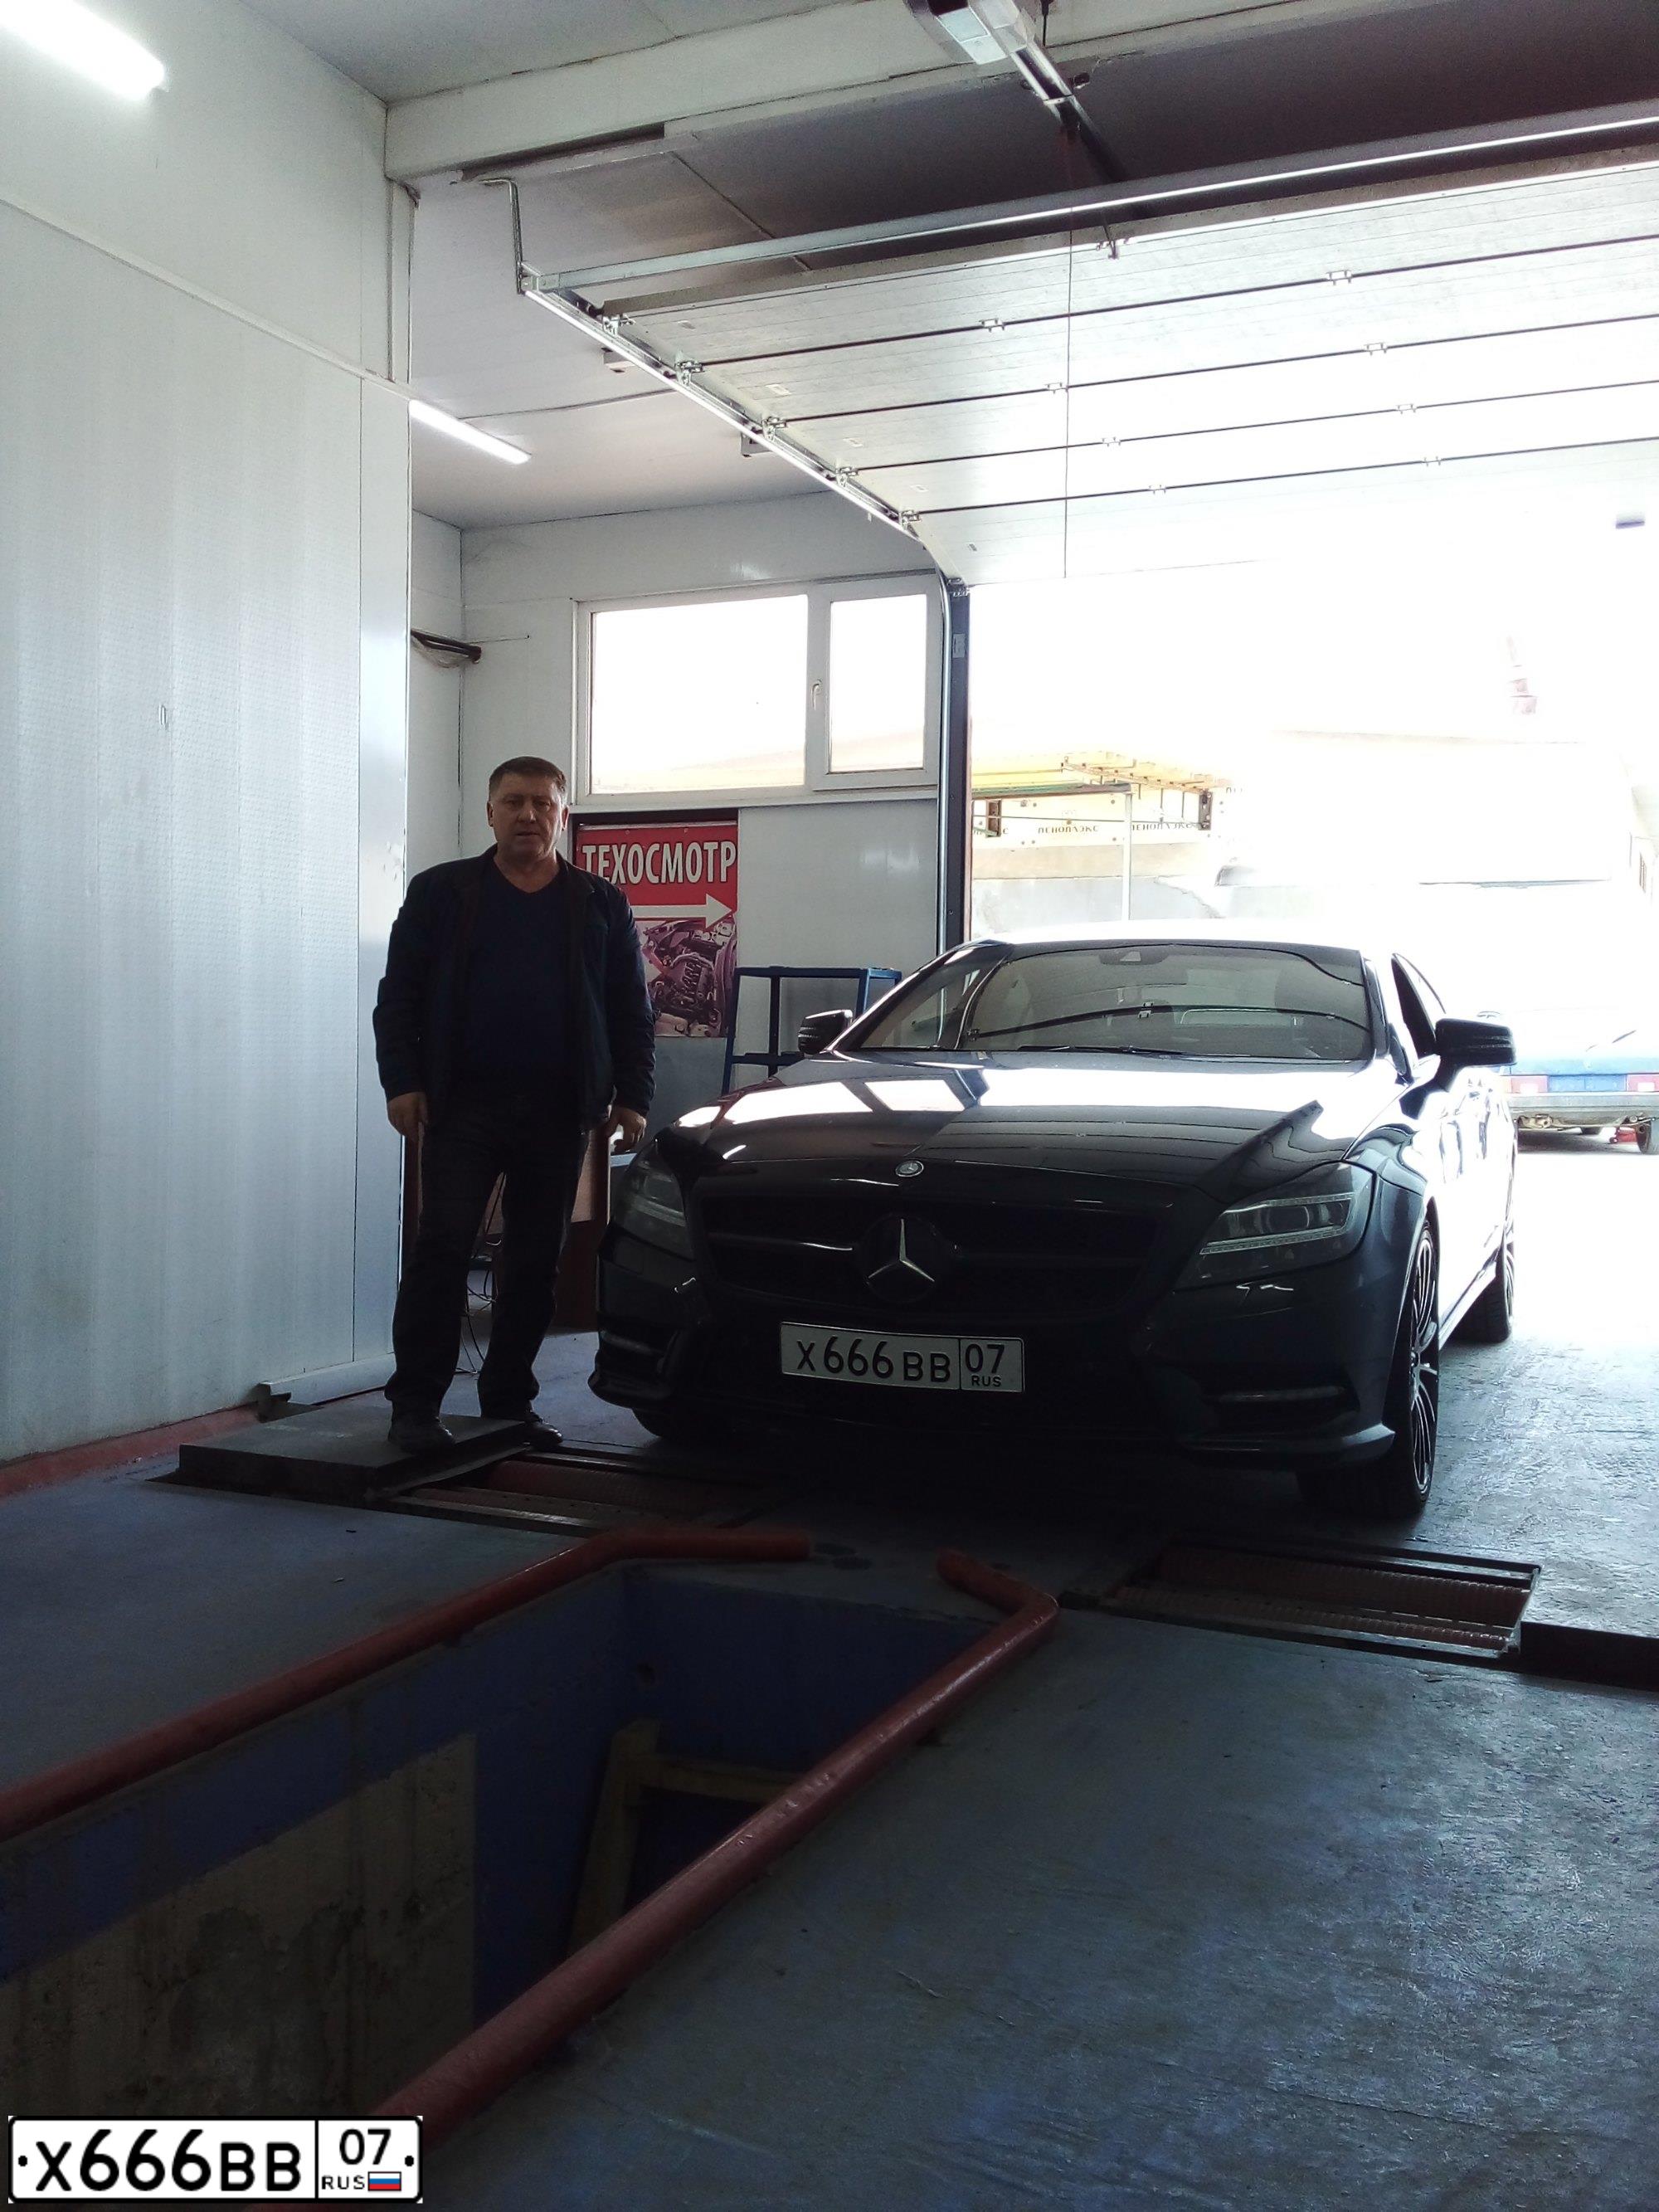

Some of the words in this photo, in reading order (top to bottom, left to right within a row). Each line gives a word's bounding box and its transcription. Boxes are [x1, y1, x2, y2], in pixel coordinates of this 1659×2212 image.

[581, 840, 737, 884] ТЕХОСМОТР
[965, 1343, 1005, 1372] 07
[971, 1375, 1001, 1387] RUS
